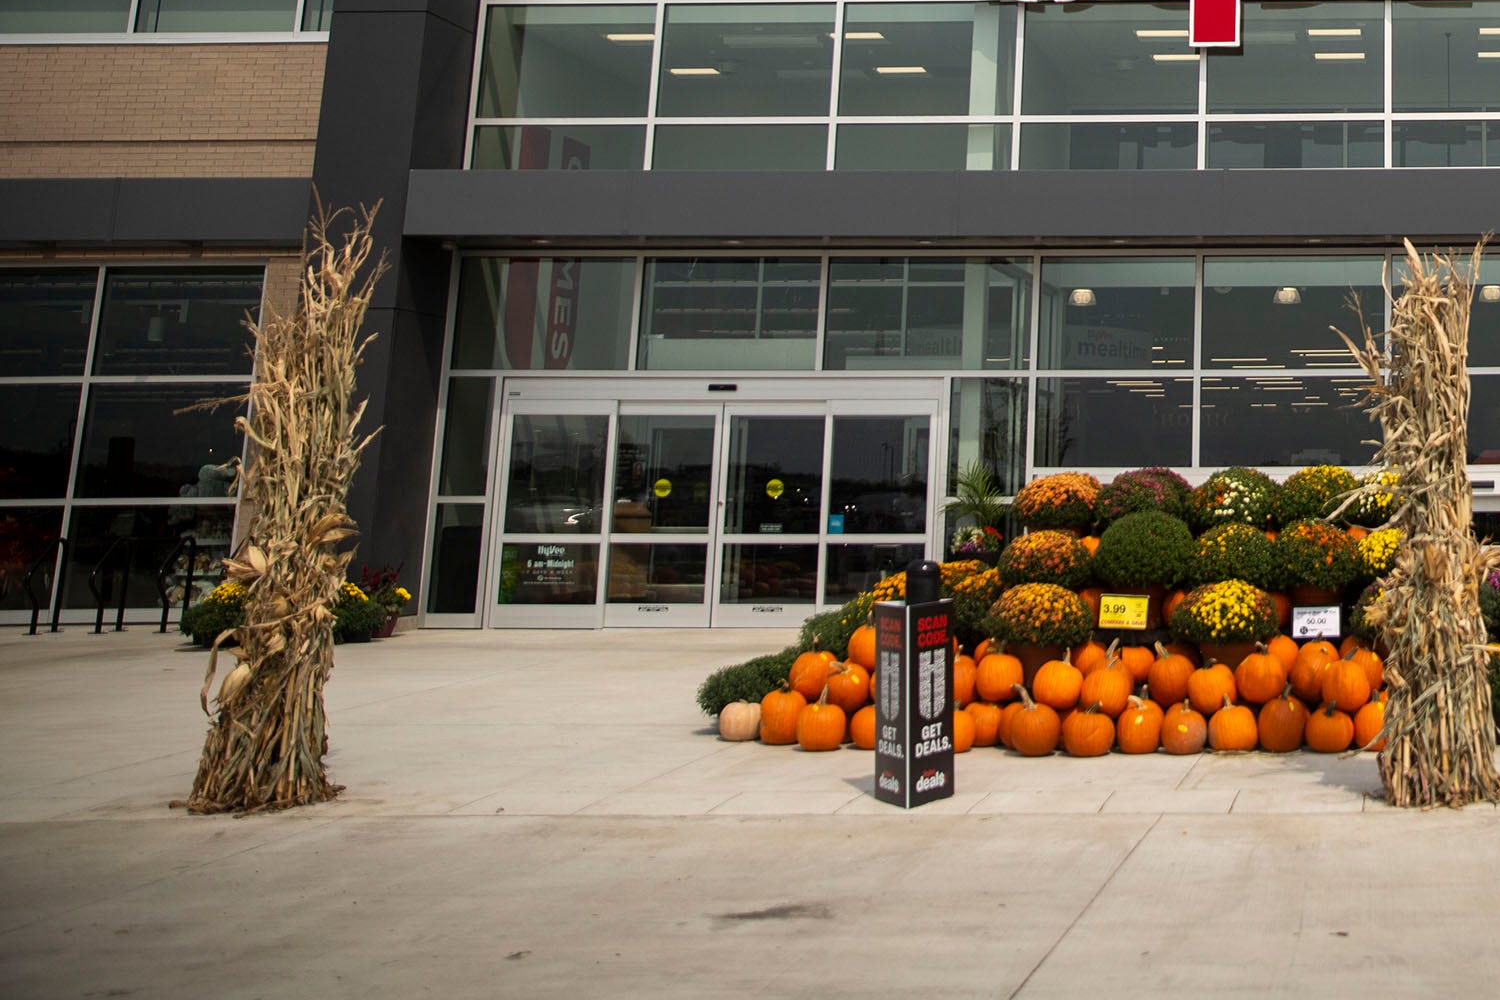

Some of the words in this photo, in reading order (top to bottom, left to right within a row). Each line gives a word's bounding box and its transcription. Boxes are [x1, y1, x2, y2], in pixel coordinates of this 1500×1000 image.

[1103, 603, 1126, 613] 3.99
[917, 614, 948, 632] SCAN
[917, 630, 949, 647] CODE.
[882, 725, 897, 740] GET
[921, 722, 943, 740] GET
[878, 740, 904, 759] DEALS.
[915, 738, 952, 757] DEALS.
